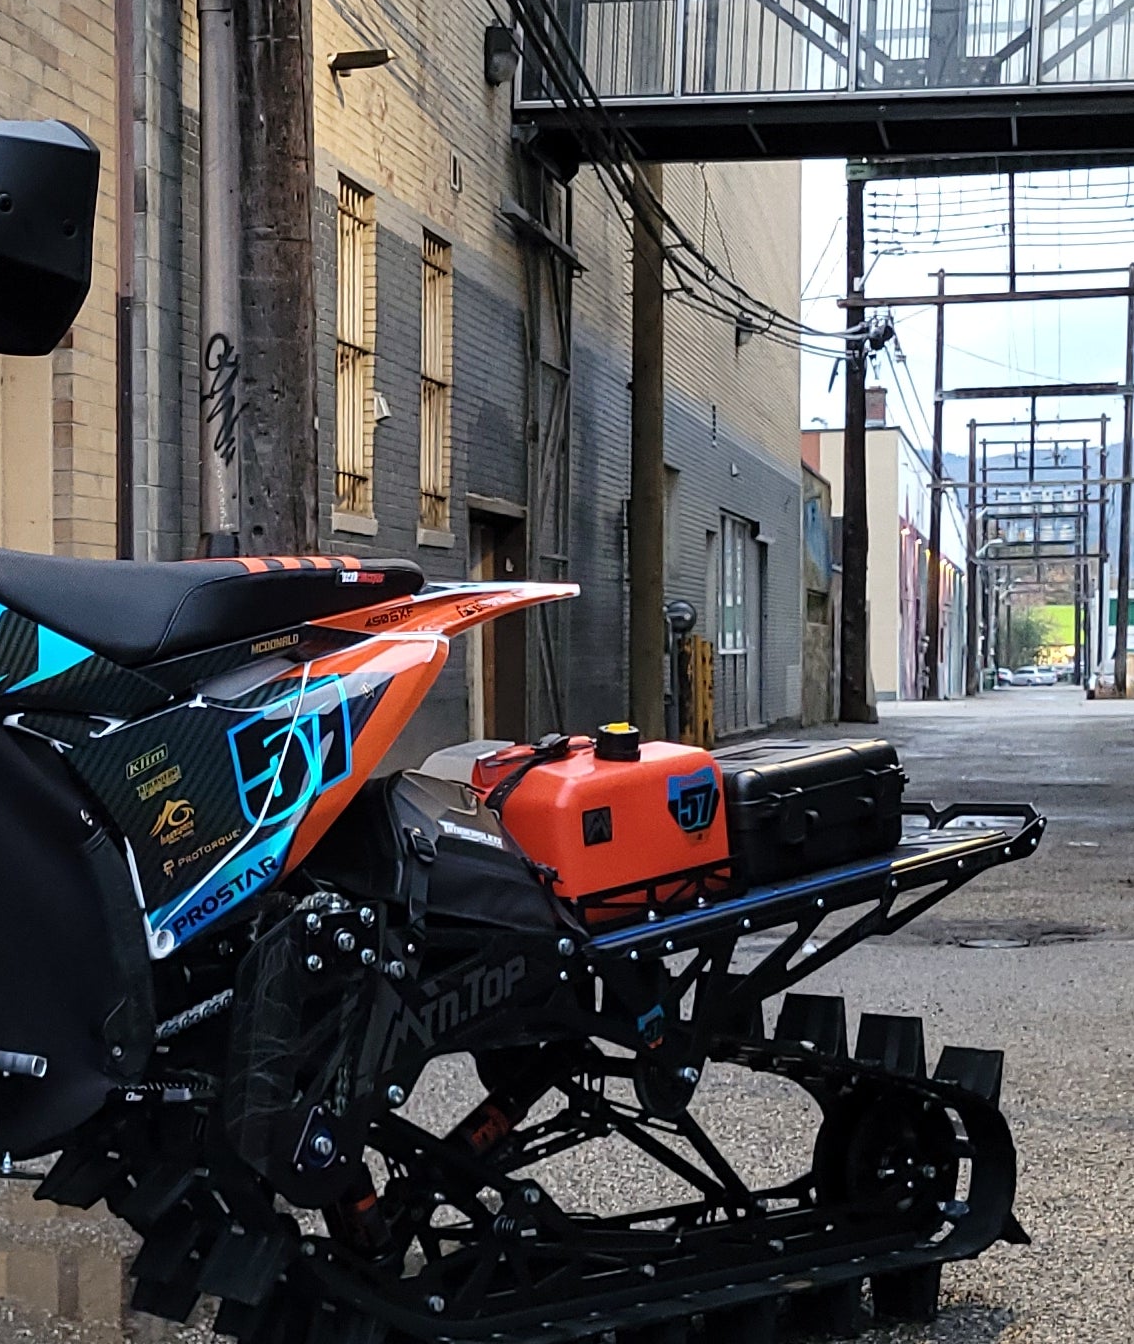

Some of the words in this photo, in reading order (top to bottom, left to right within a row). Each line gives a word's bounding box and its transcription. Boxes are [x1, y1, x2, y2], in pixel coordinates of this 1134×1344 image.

[250, 633, 300, 656] MCDONALD
[677, 783, 716, 831] 57
[171, 854, 280, 937] PROSTAR
